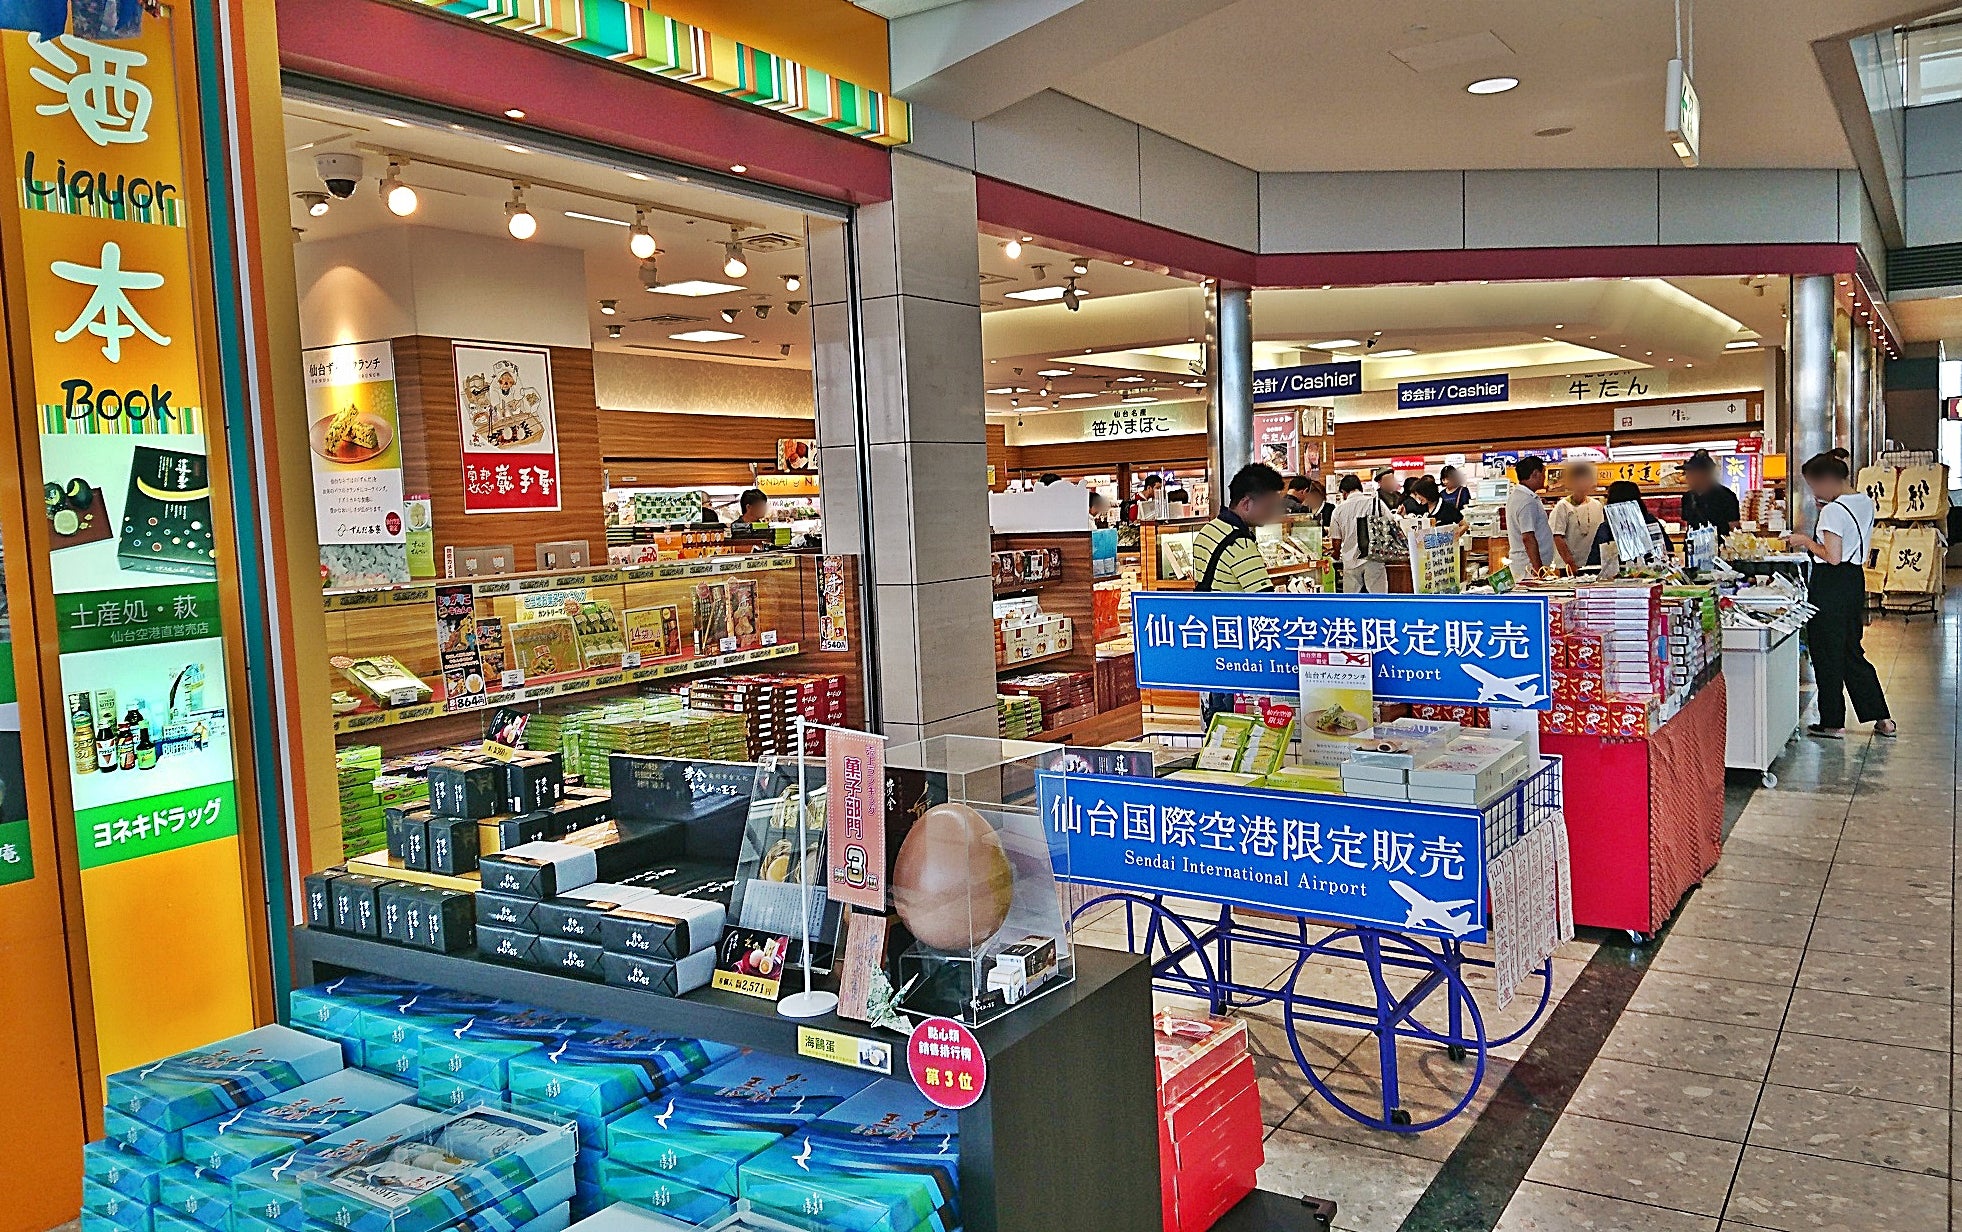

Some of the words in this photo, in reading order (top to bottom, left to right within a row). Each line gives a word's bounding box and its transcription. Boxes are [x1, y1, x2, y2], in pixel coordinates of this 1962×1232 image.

[28, 32, 153, 146] 酒
[24, 151, 177, 212] Liquor
[51, 242, 171, 363] 本
[309, 357, 381, 377] 仙台ずランチ
[1252, 377, 1279, 395] 会計
[1290, 371, 1357, 391] Cashier
[1447, 382, 1505, 399] Cashier
[1568, 375, 1649, 400] 牛たん
[1092, 417, 1170, 437] 笹かまぼこ
[70, 595, 198, 630] 土産処・萩
[110, 621, 210, 644] 仙台空港直営売店
[1144, 613, 1530, 660] 仙台国際空港限定販売
[1215, 657, 1263, 674] Sendai
[1378, 665, 1442, 683] Airport
[1305, 671, 1367, 681] 仙台ずんだクランチ
[843, 756, 864, 840] 菓子部門
[93, 797, 222, 849] ヨネキドラッグ
[1050, 793, 1467, 882] 仙台国際空港限定販売
[1124, 848, 1176, 871] Sendai
[1181, 856, 1290, 888] International
[1297, 871, 1368, 897] Airport
